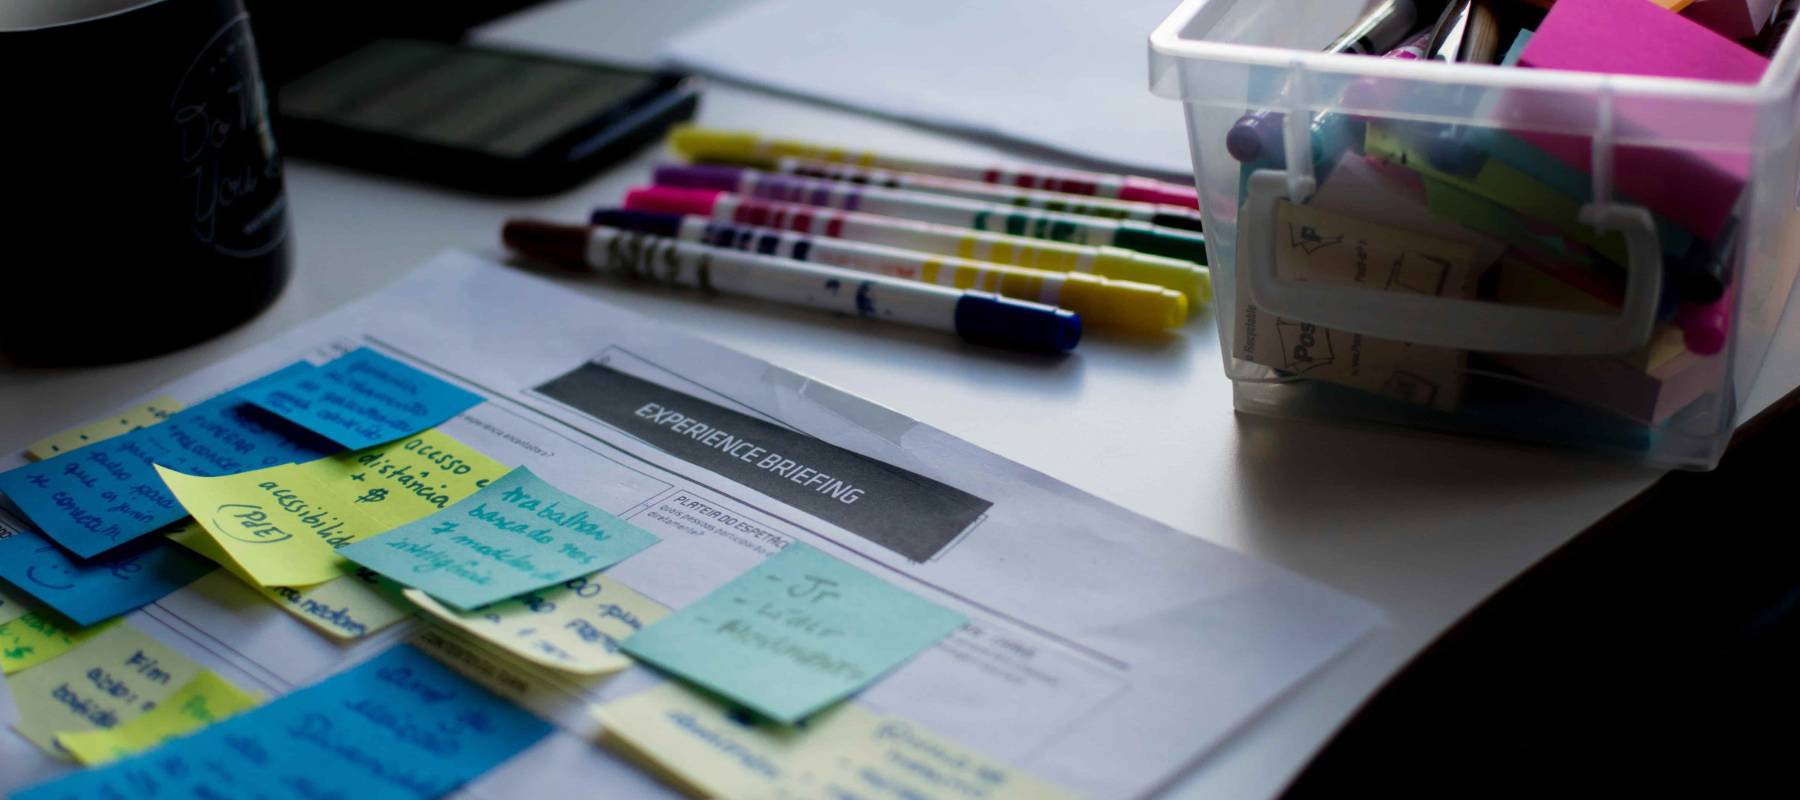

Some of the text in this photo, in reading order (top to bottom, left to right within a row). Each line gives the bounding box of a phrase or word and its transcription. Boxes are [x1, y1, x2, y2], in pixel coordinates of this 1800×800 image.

[403, 440, 471, 475] acesso
[633, 402, 865, 504] EXPERIENCE BRIEFING
[357, 452, 450, 509] distância
[646, 511, 705, 536] diretamente?
[673, 495, 721, 519] PLATEIA
[716, 513, 738, 527] DO
[680, 512, 717, 531] pessoas
[786, 574, 841, 604] Jr
